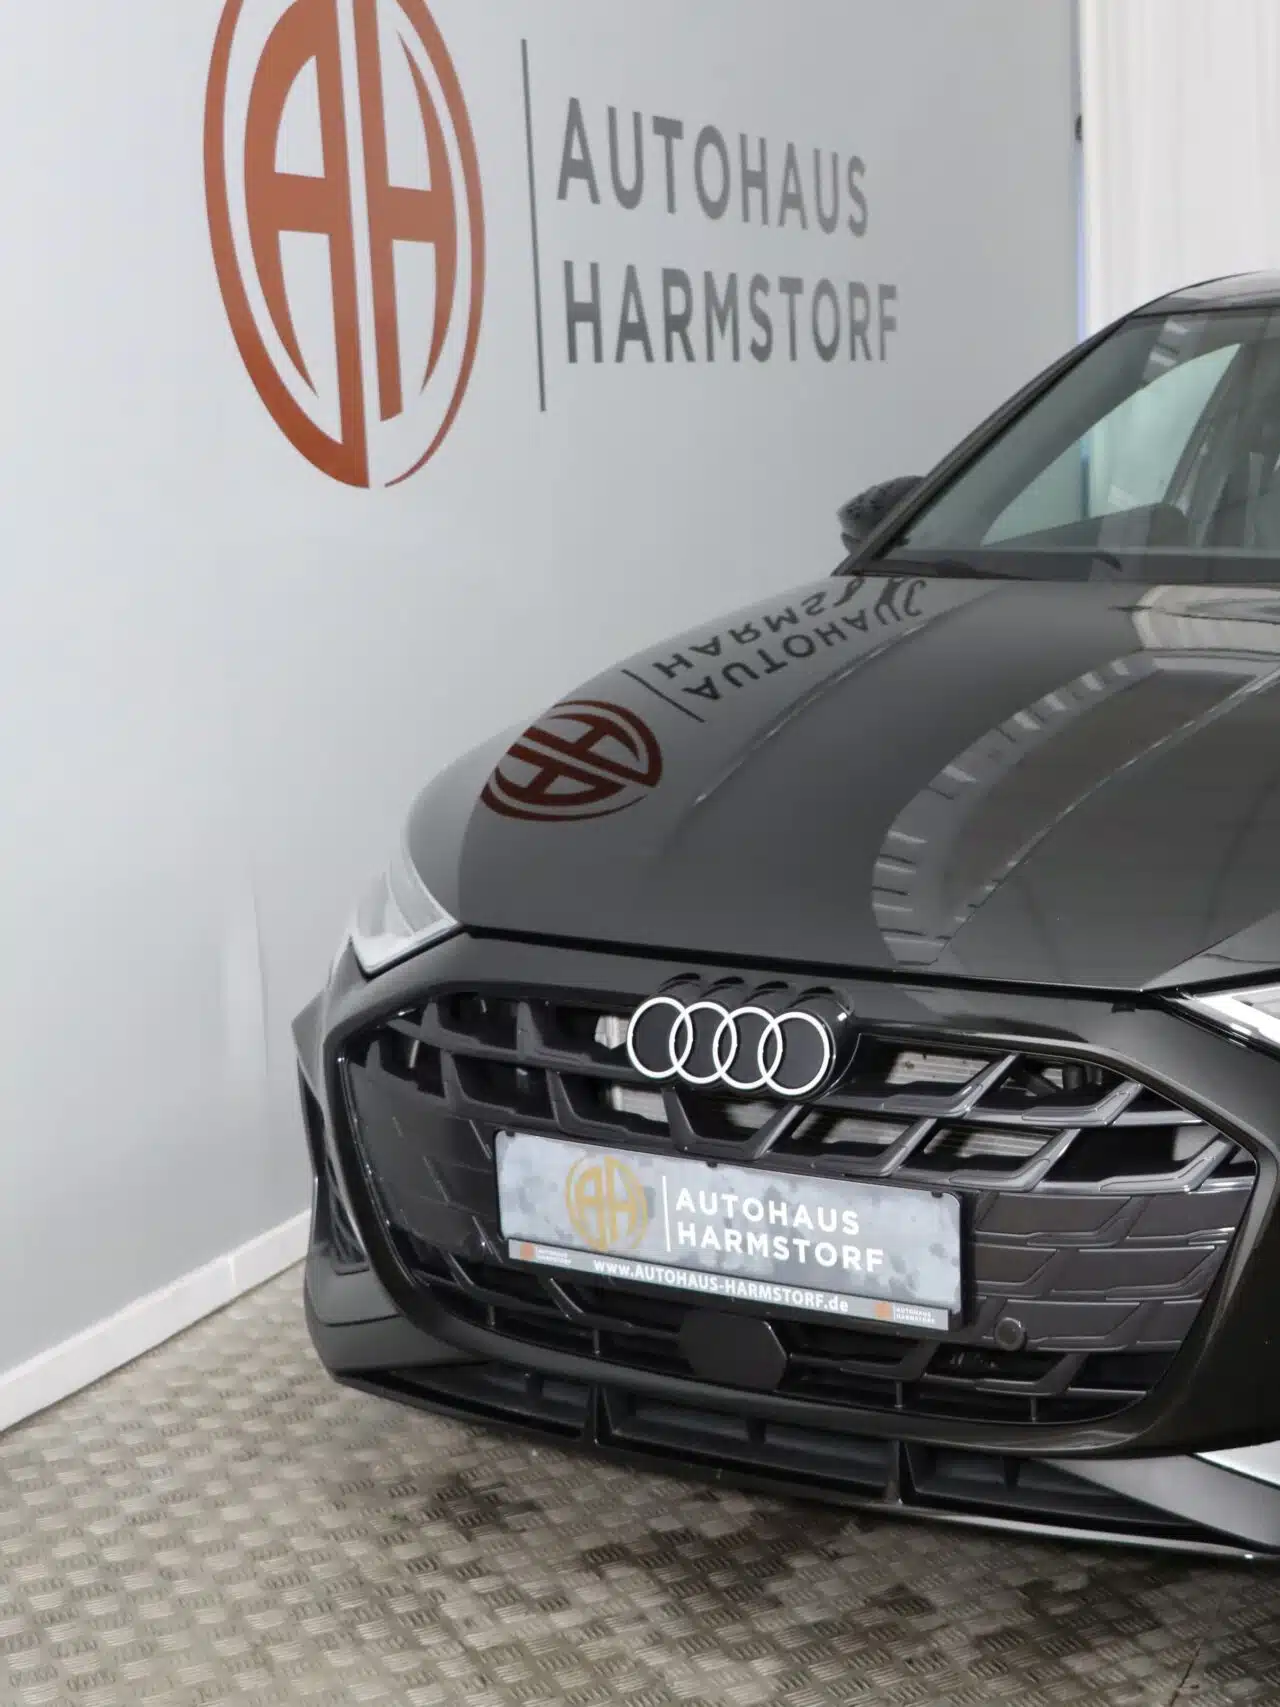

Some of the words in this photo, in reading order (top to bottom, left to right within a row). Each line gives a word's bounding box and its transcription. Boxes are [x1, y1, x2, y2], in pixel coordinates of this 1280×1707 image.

[557, 97, 868, 238] AUTOHAUS
[564, 260, 899, 363] HARMSTORF
[675, 1187, 860, 1236] AUTOHAUS
[677, 1221, 885, 1273] HARMSTORF
[593, 1259, 849, 1313] www.AUTOHAUS-HARMSTORF.de
